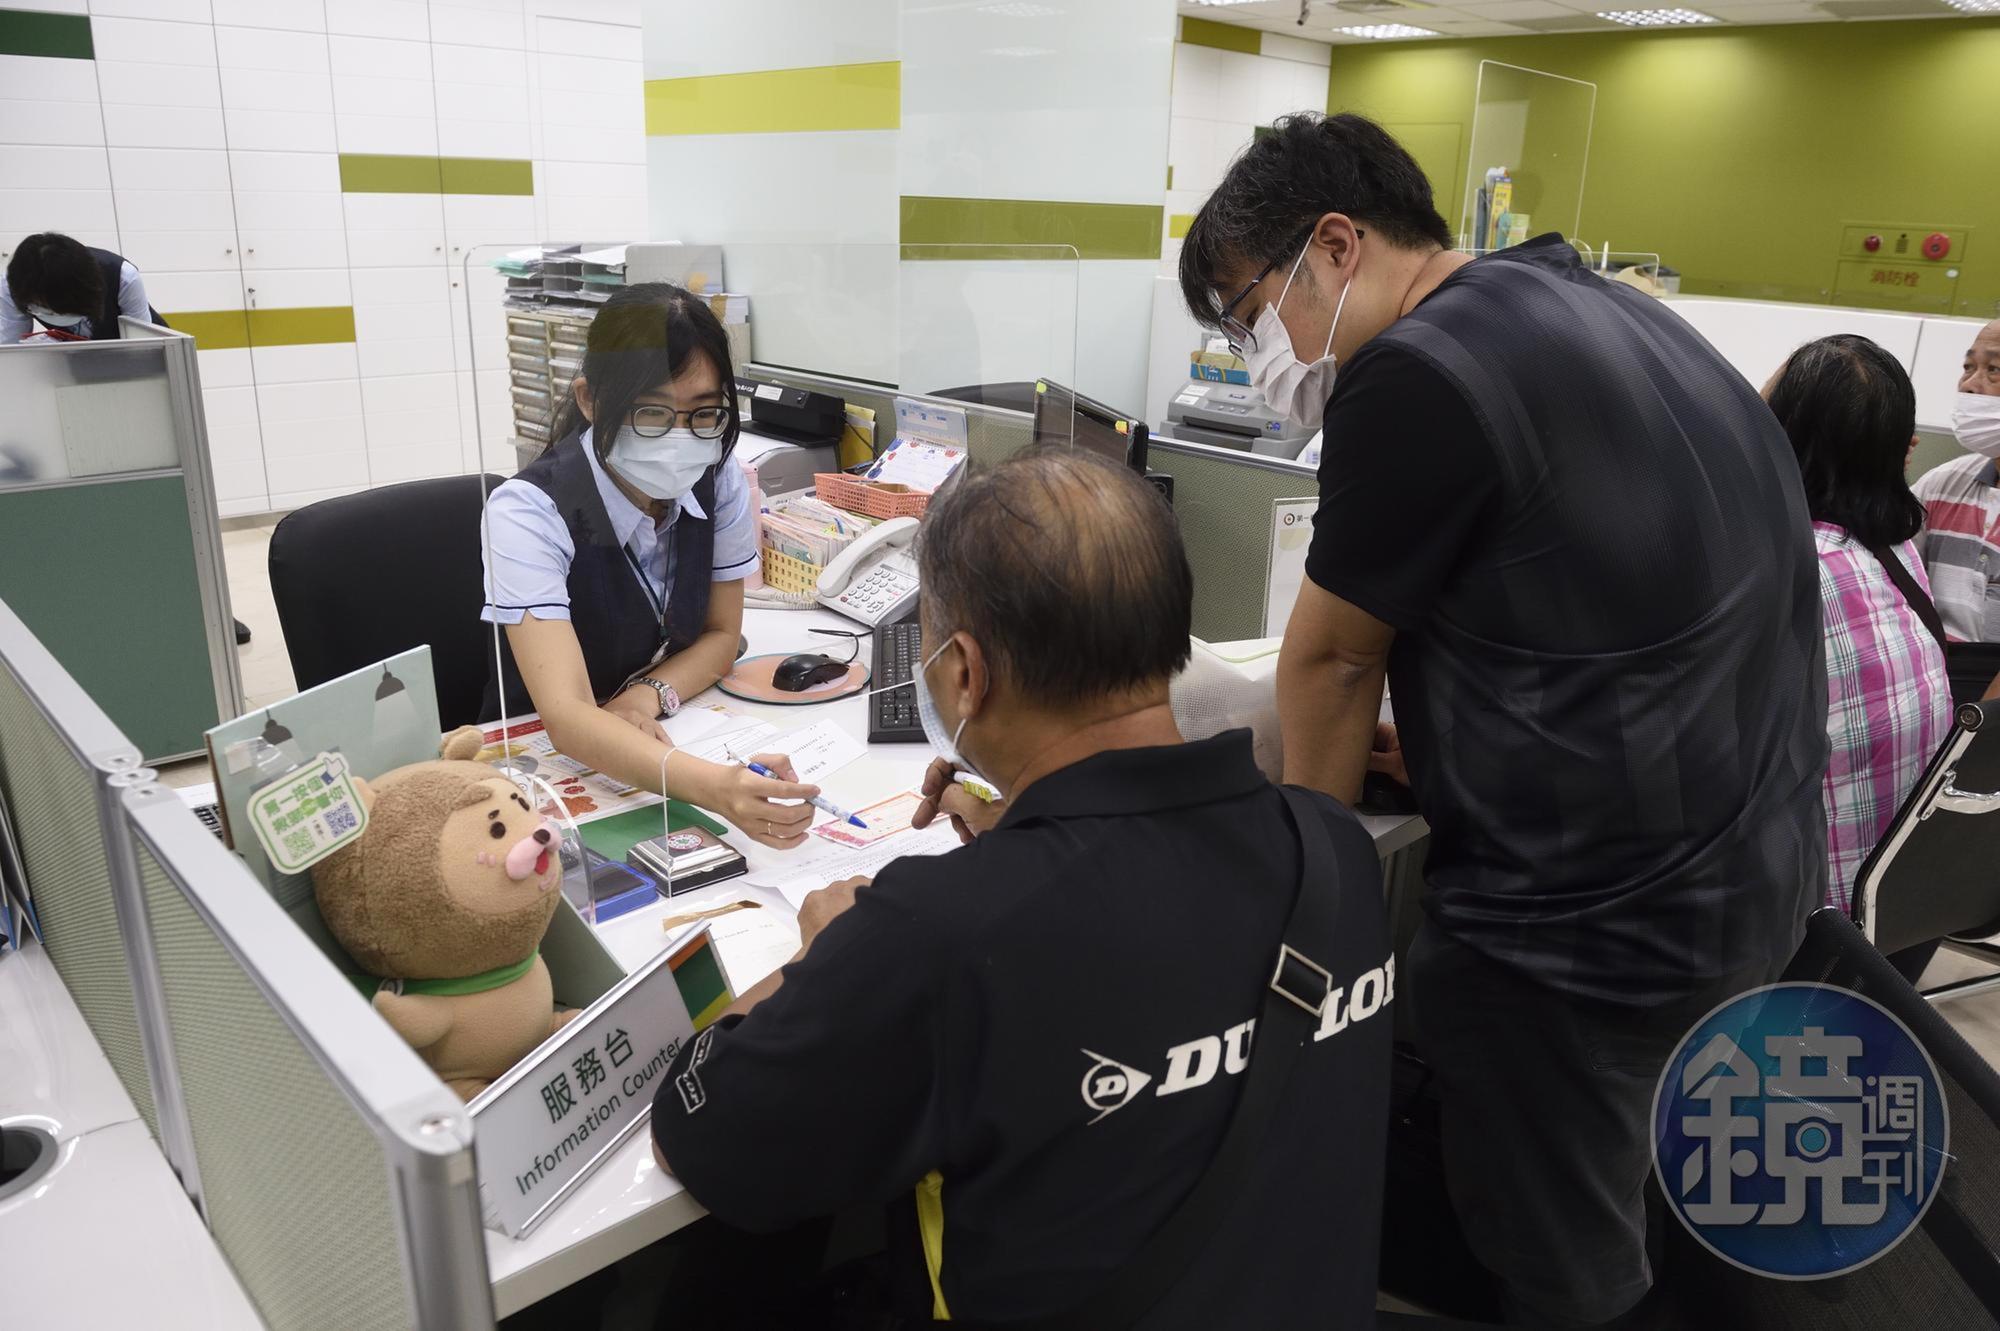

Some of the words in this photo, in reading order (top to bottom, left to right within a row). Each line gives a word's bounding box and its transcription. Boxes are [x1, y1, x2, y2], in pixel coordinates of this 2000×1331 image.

[540, 1028, 634, 1124] 服務台
[1156, 952, 1395, 1097] DULO
[515, 1101, 621, 1196] Information
[622, 1036, 682, 1098] Counter
